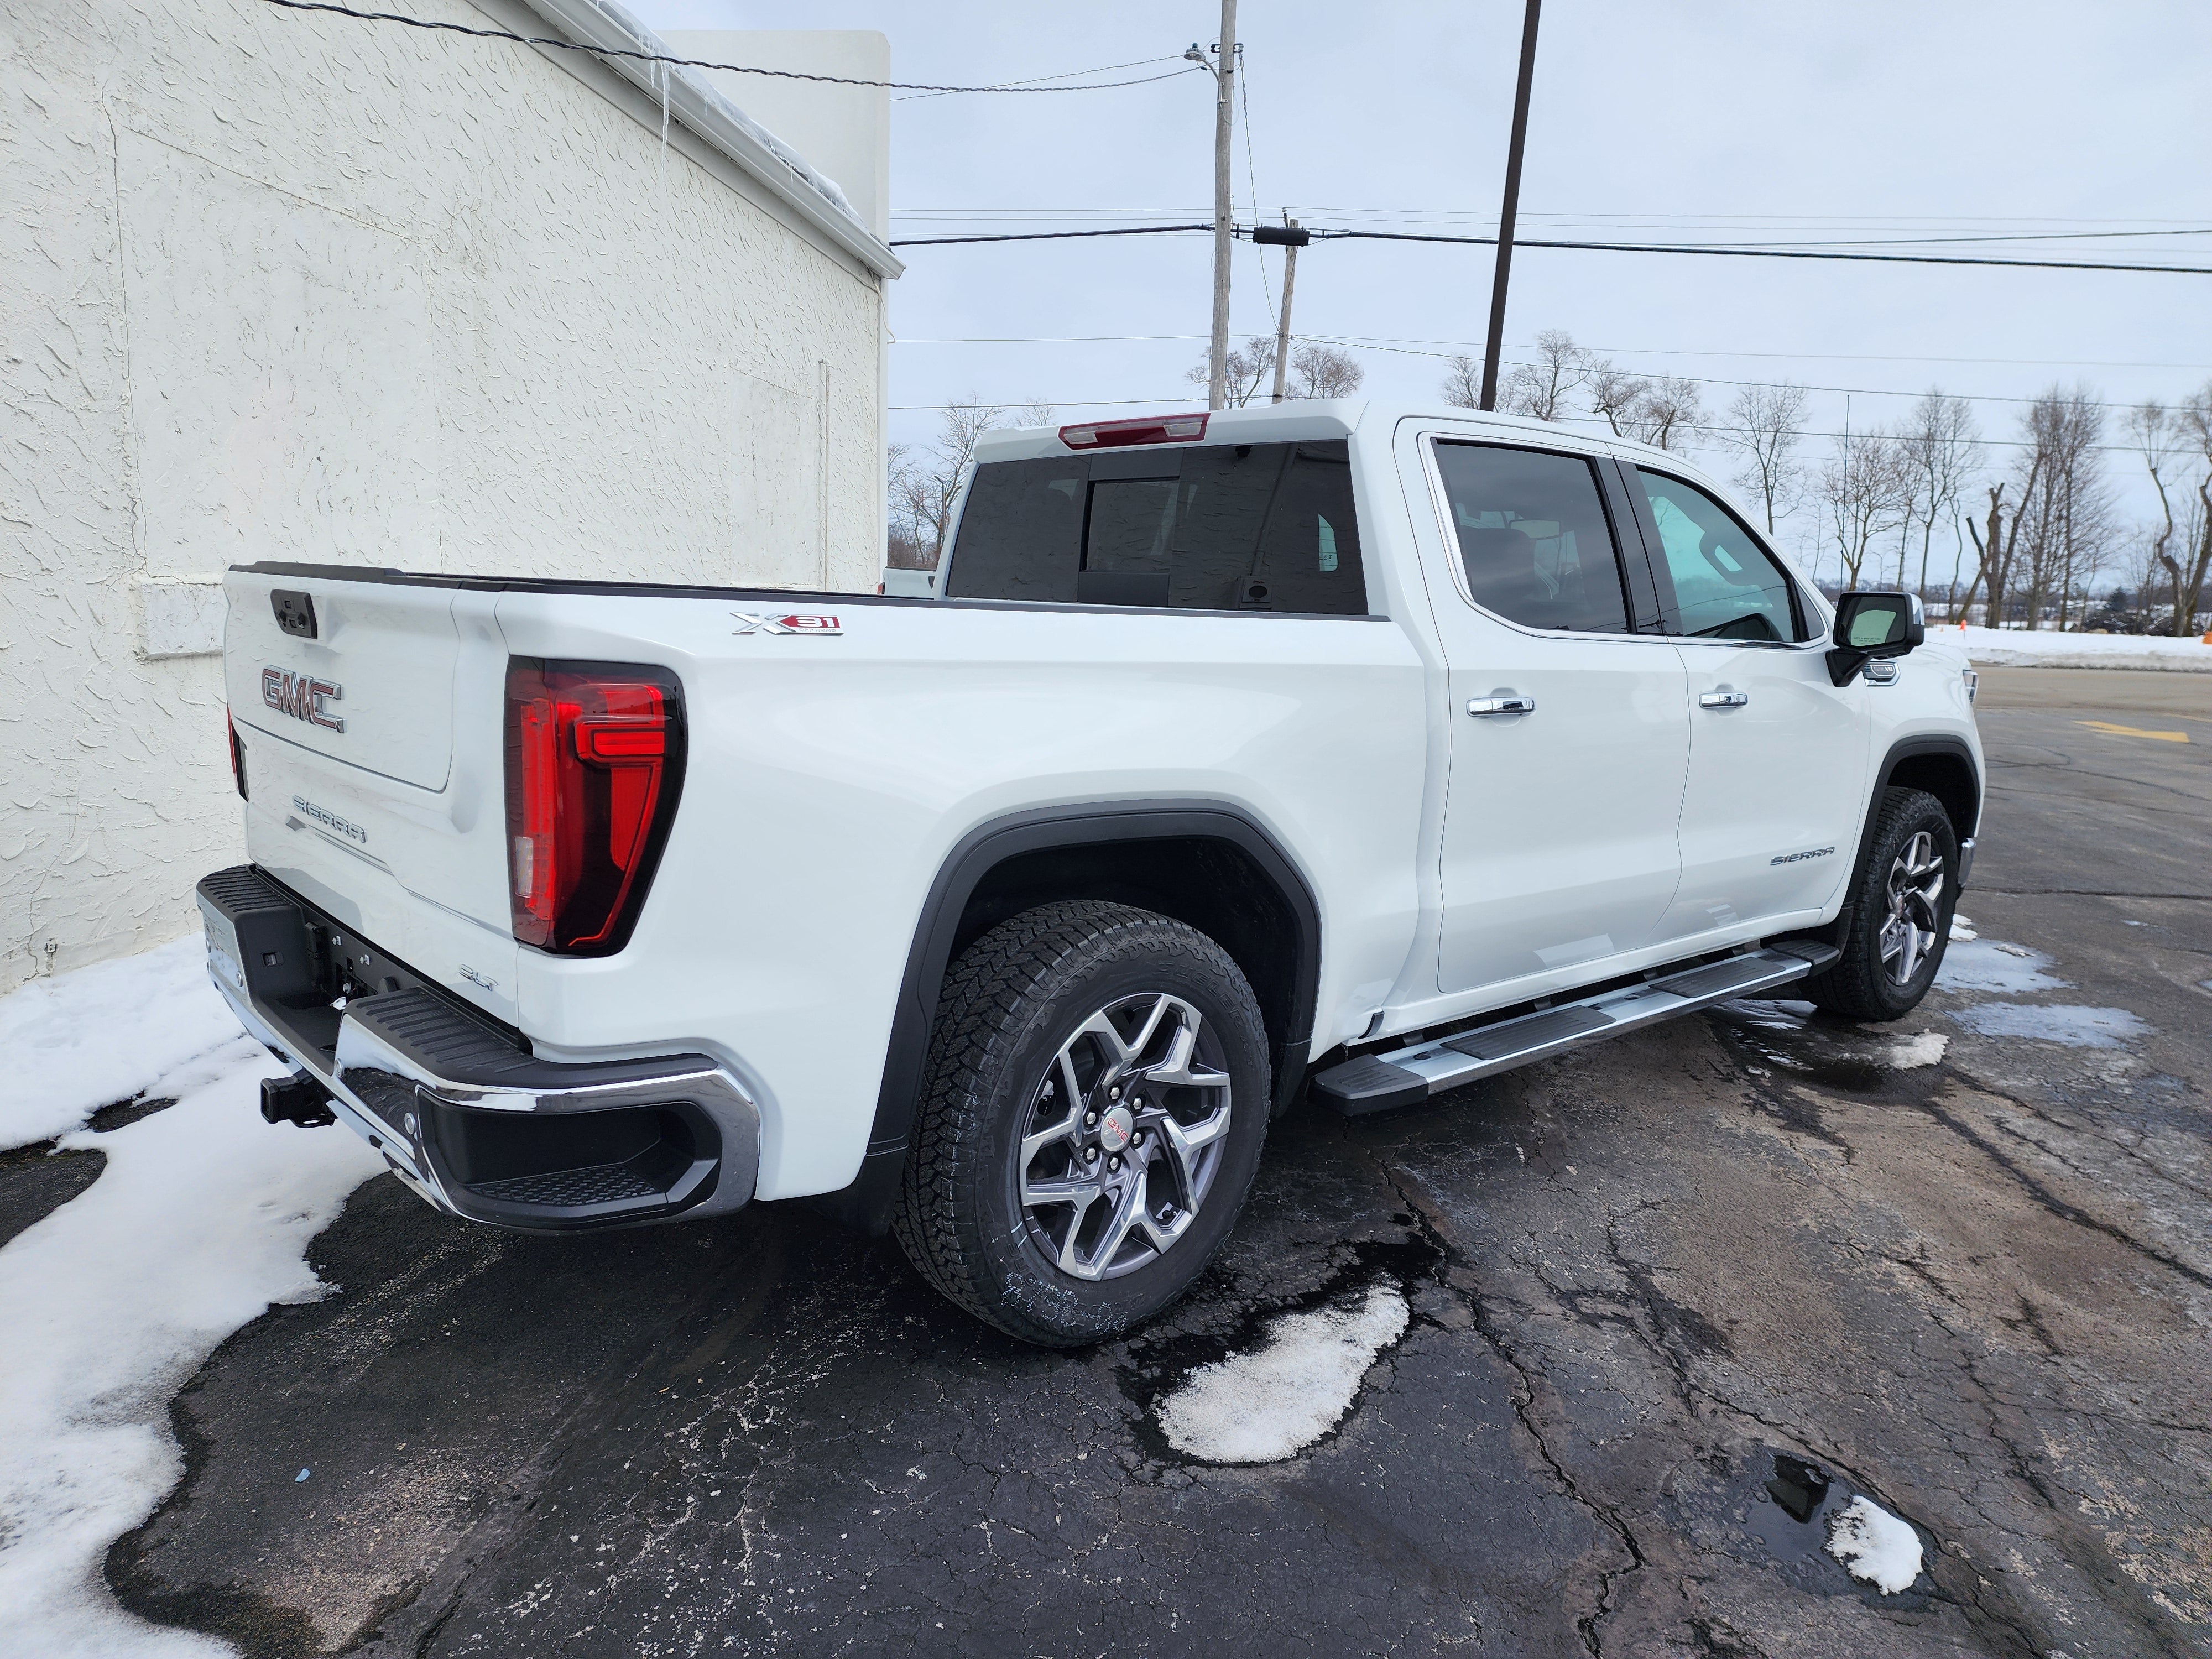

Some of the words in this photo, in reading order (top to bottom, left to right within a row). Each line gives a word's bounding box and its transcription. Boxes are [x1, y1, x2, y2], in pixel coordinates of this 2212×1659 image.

[262, 665, 344, 733] GMC
[292, 795, 368, 843] SIERRA
[1770, 847, 1835, 865] SIERRA
[458, 964, 498, 991] SLT
[1107, 1117, 1129, 1142] GMC
